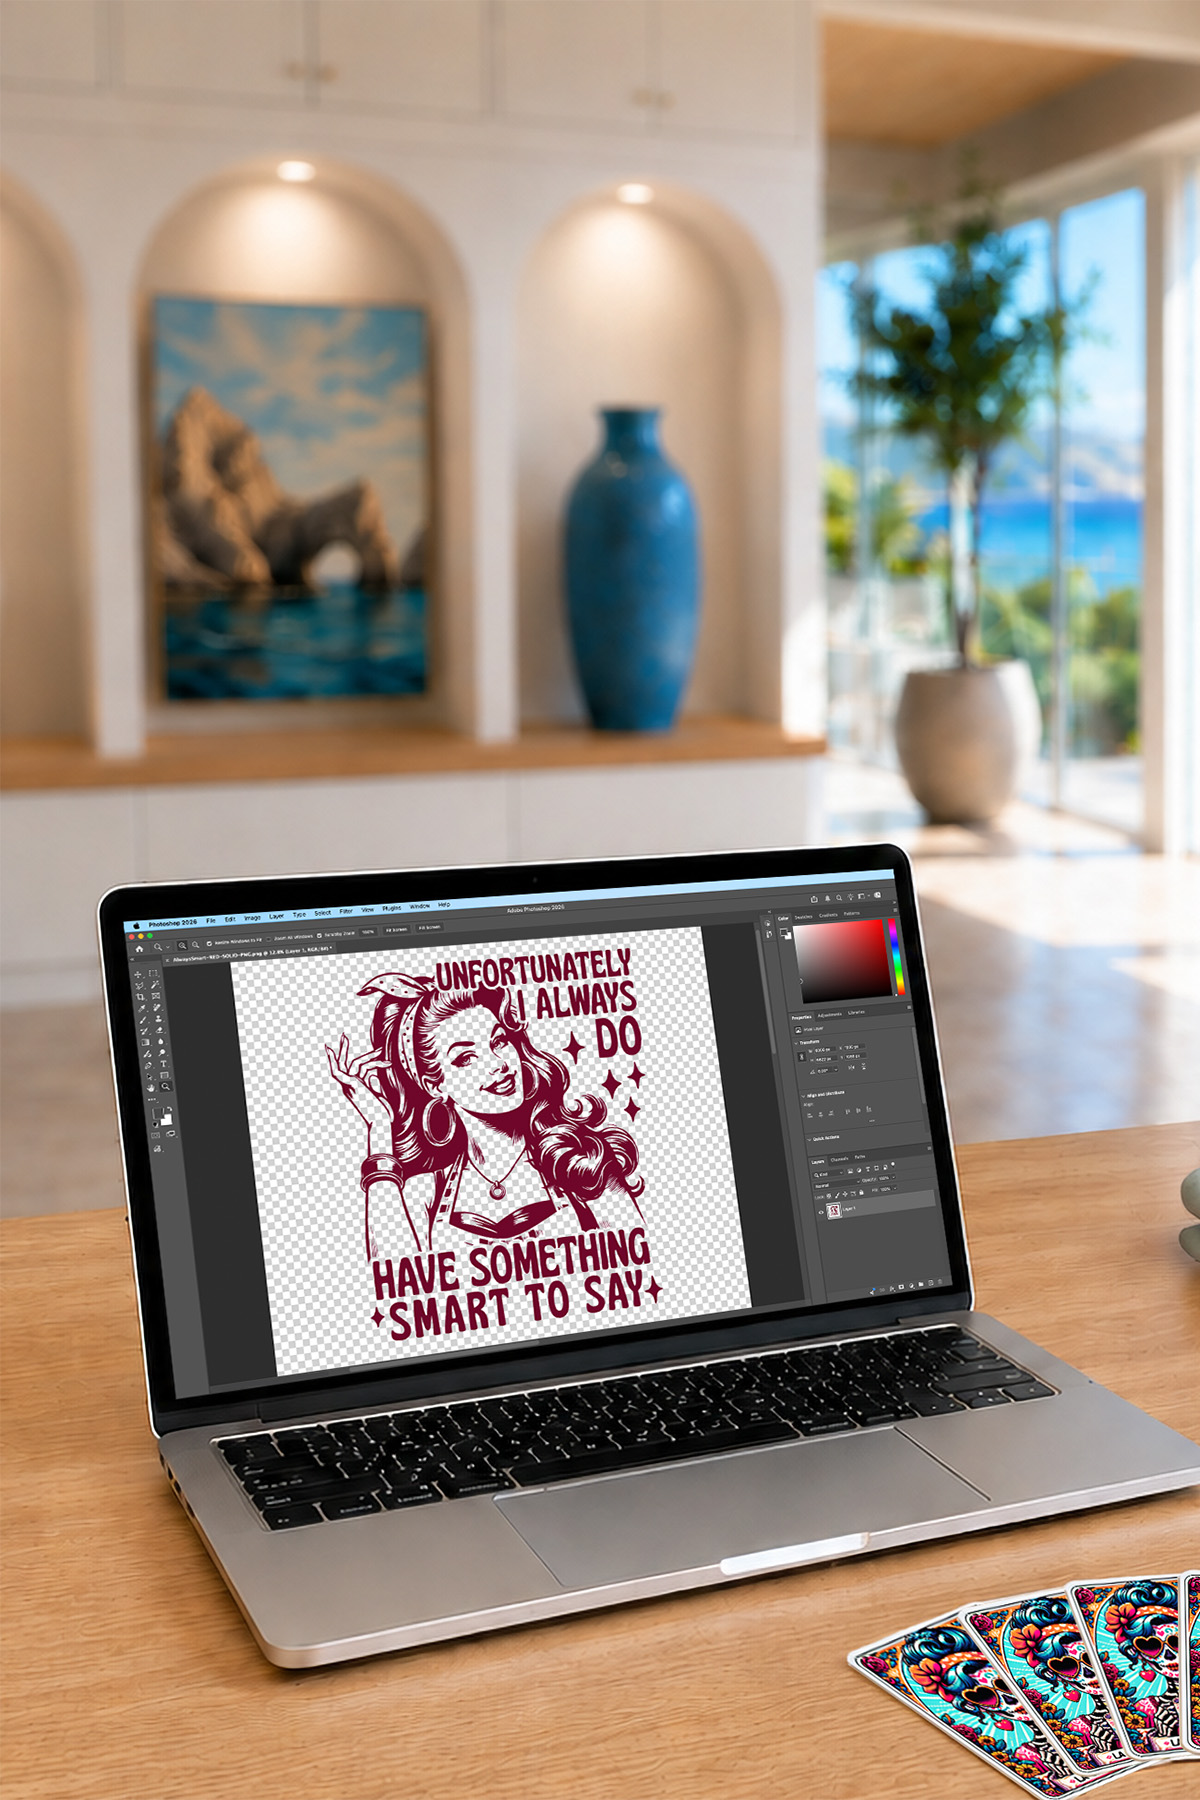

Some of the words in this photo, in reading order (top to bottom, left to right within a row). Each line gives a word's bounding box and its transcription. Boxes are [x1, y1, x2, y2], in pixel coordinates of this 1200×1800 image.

[149, 920, 180, 928] Photoshop
[436, 948, 630, 991] UNFORTUNATELY
[517, 990, 526, 1021] I
[537, 981, 637, 1019] ALWAYS
[595, 1016, 642, 1058] DO
[373, 1251, 460, 1300] HAVE
[469, 1227, 650, 1286] SOMETHING
[389, 1287, 509, 1341] SMART
[525, 1280, 569, 1321] TO
[585, 1269, 643, 1313] SAY
[1170, 1738, 1180, 1747] L
